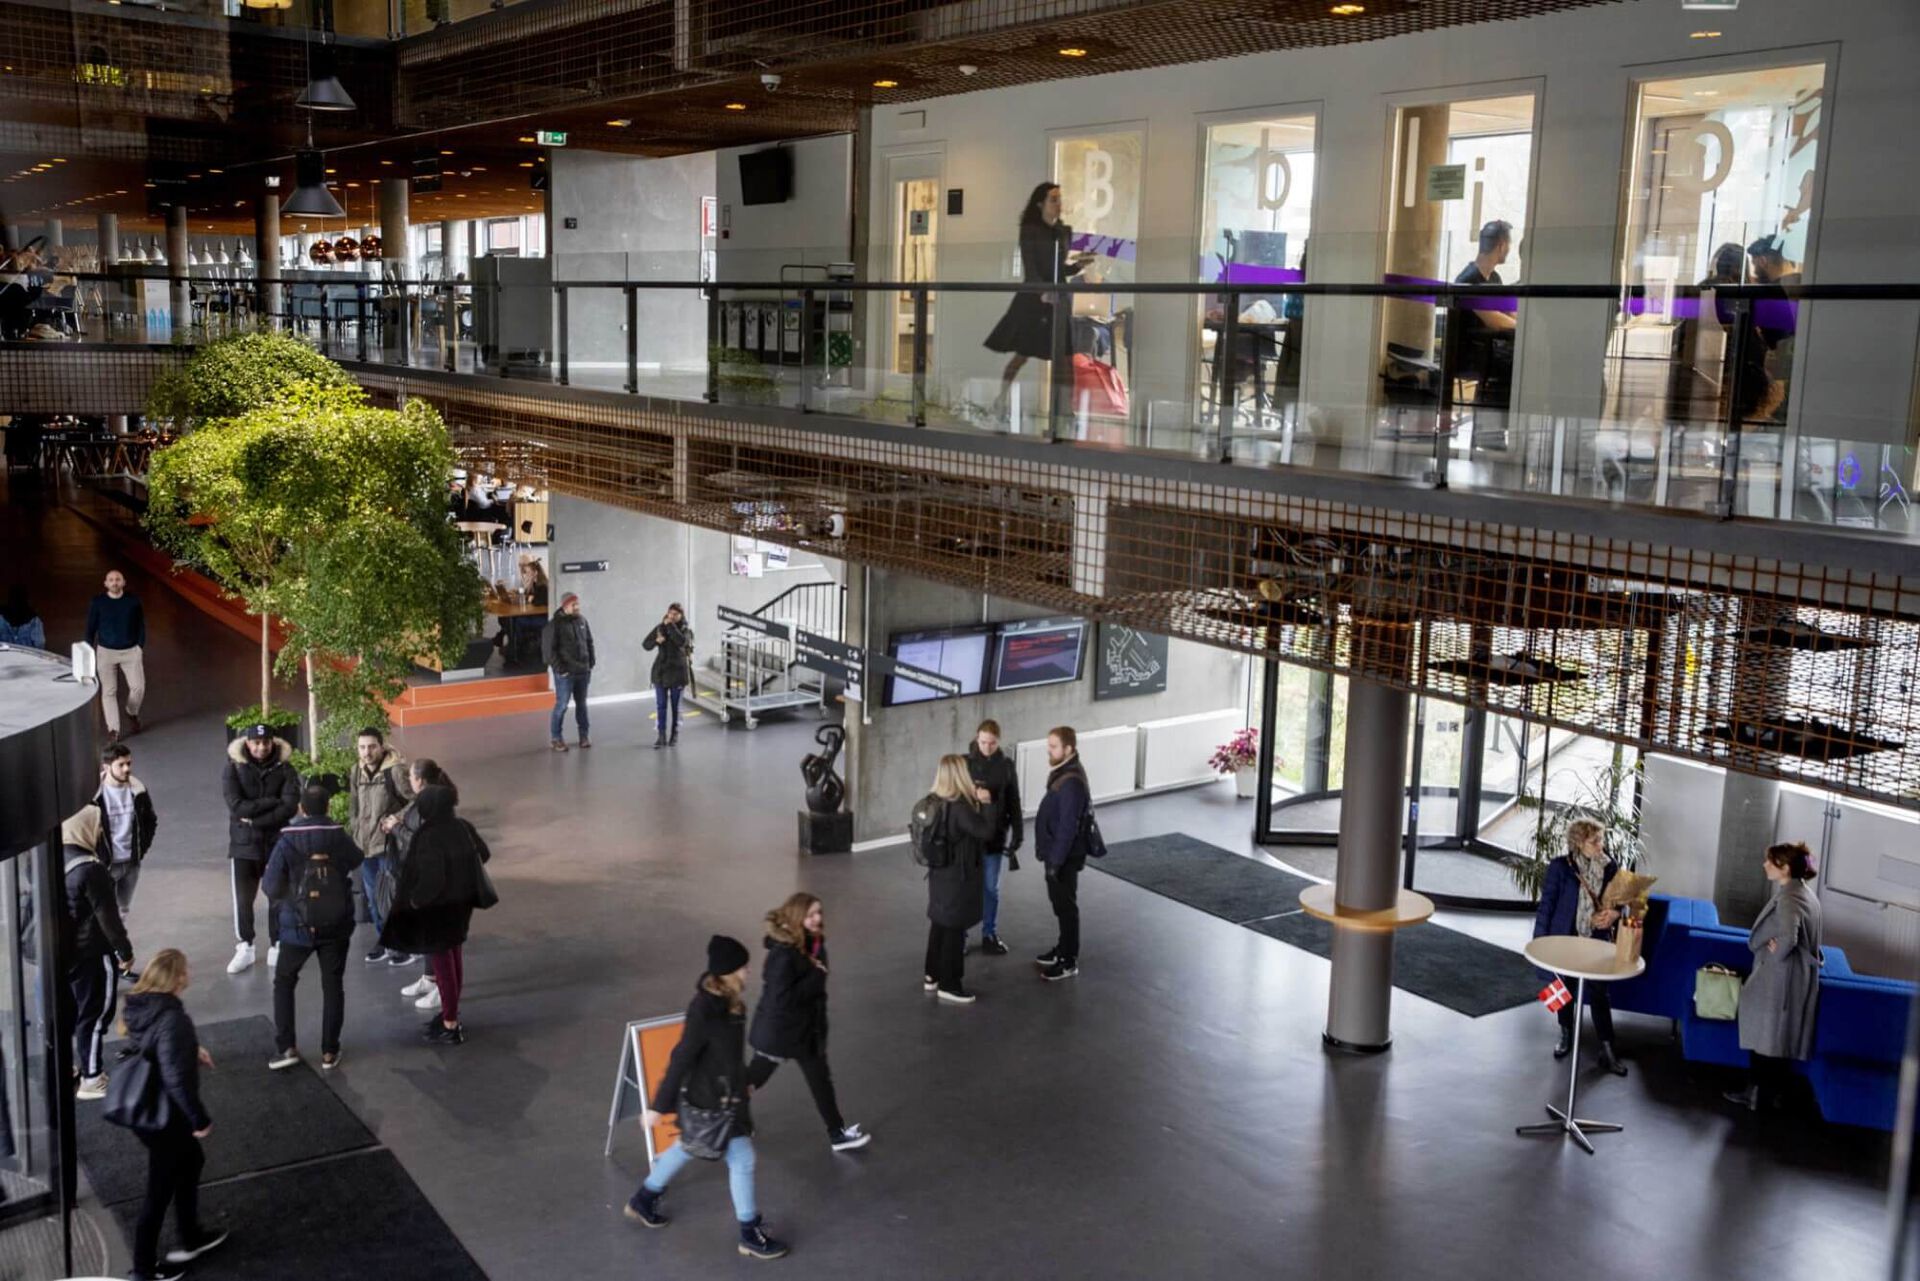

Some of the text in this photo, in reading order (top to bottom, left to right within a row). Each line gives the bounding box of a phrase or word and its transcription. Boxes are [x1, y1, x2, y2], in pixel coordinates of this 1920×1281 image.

[1085, 149, 1114, 219] B
[1257, 128, 1291, 210] b
[257, 724, 265, 735] S
